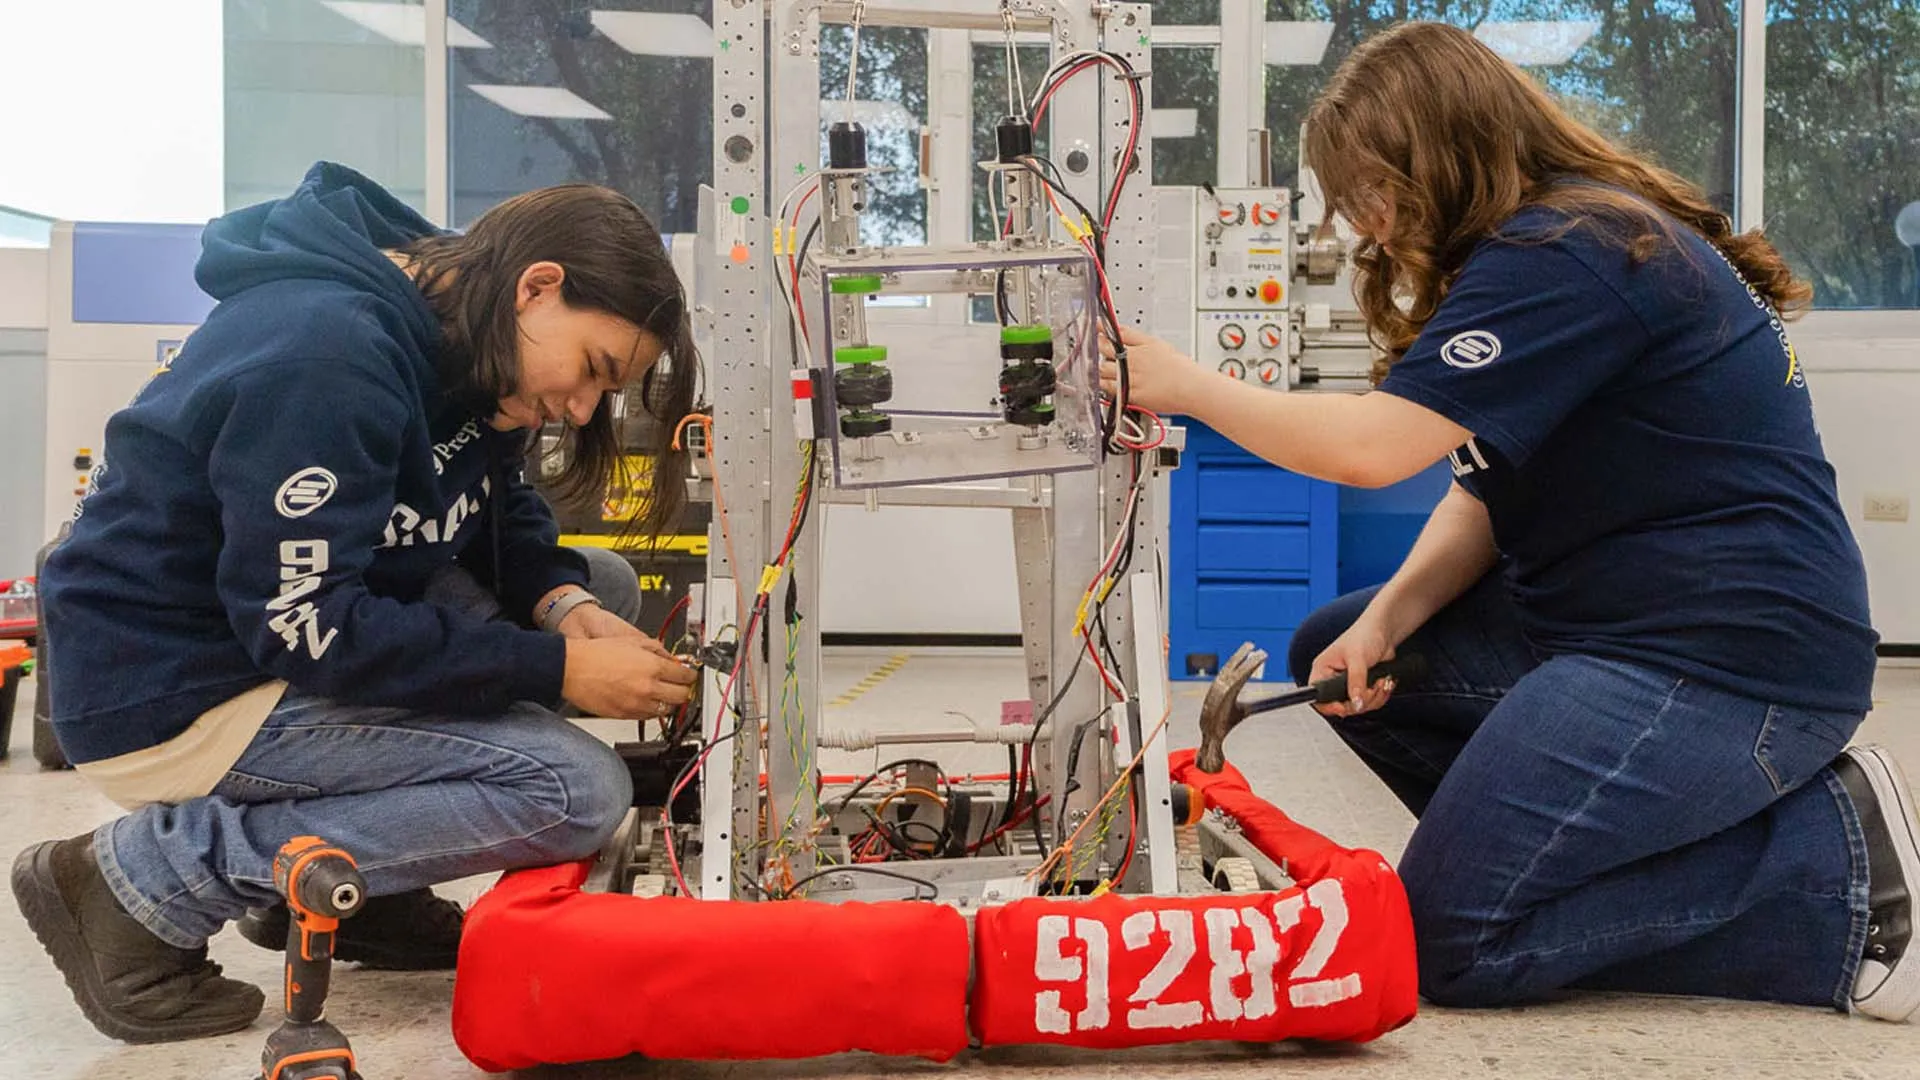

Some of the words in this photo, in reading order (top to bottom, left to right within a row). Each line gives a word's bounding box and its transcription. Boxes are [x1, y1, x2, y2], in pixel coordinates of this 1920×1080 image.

[432, 418, 483, 460] Prep
[639, 574, 665, 591] EY
[1035, 879, 1361, 1033] 9282
